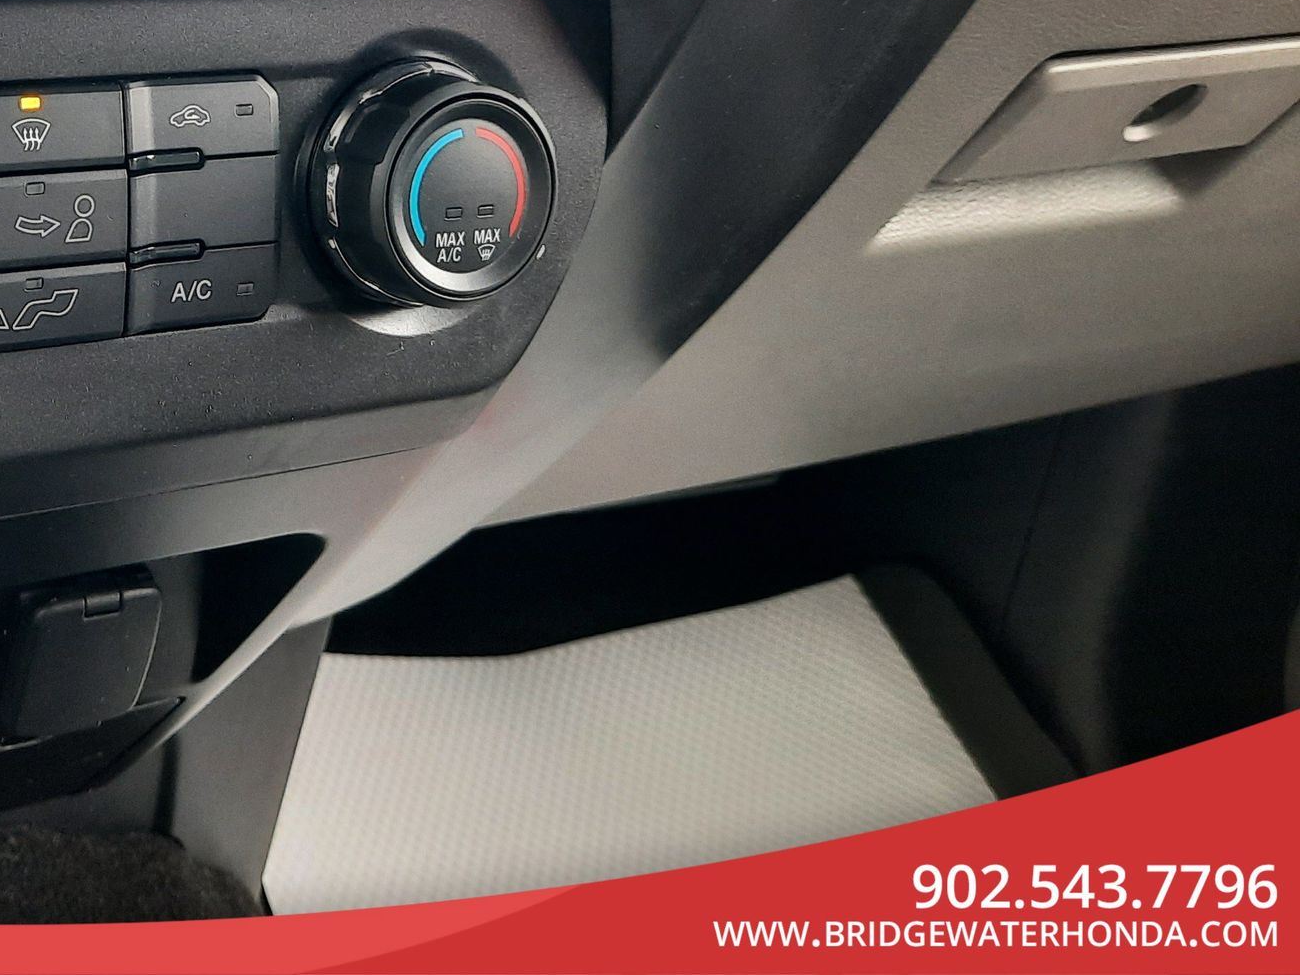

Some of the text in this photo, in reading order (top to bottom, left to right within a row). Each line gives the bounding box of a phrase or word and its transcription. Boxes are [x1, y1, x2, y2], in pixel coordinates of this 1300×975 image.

[436, 231, 465, 247] MAX
[474, 228, 501, 244] MAX
[436, 246, 462, 263] A/C
[171, 279, 212, 304] A/C
